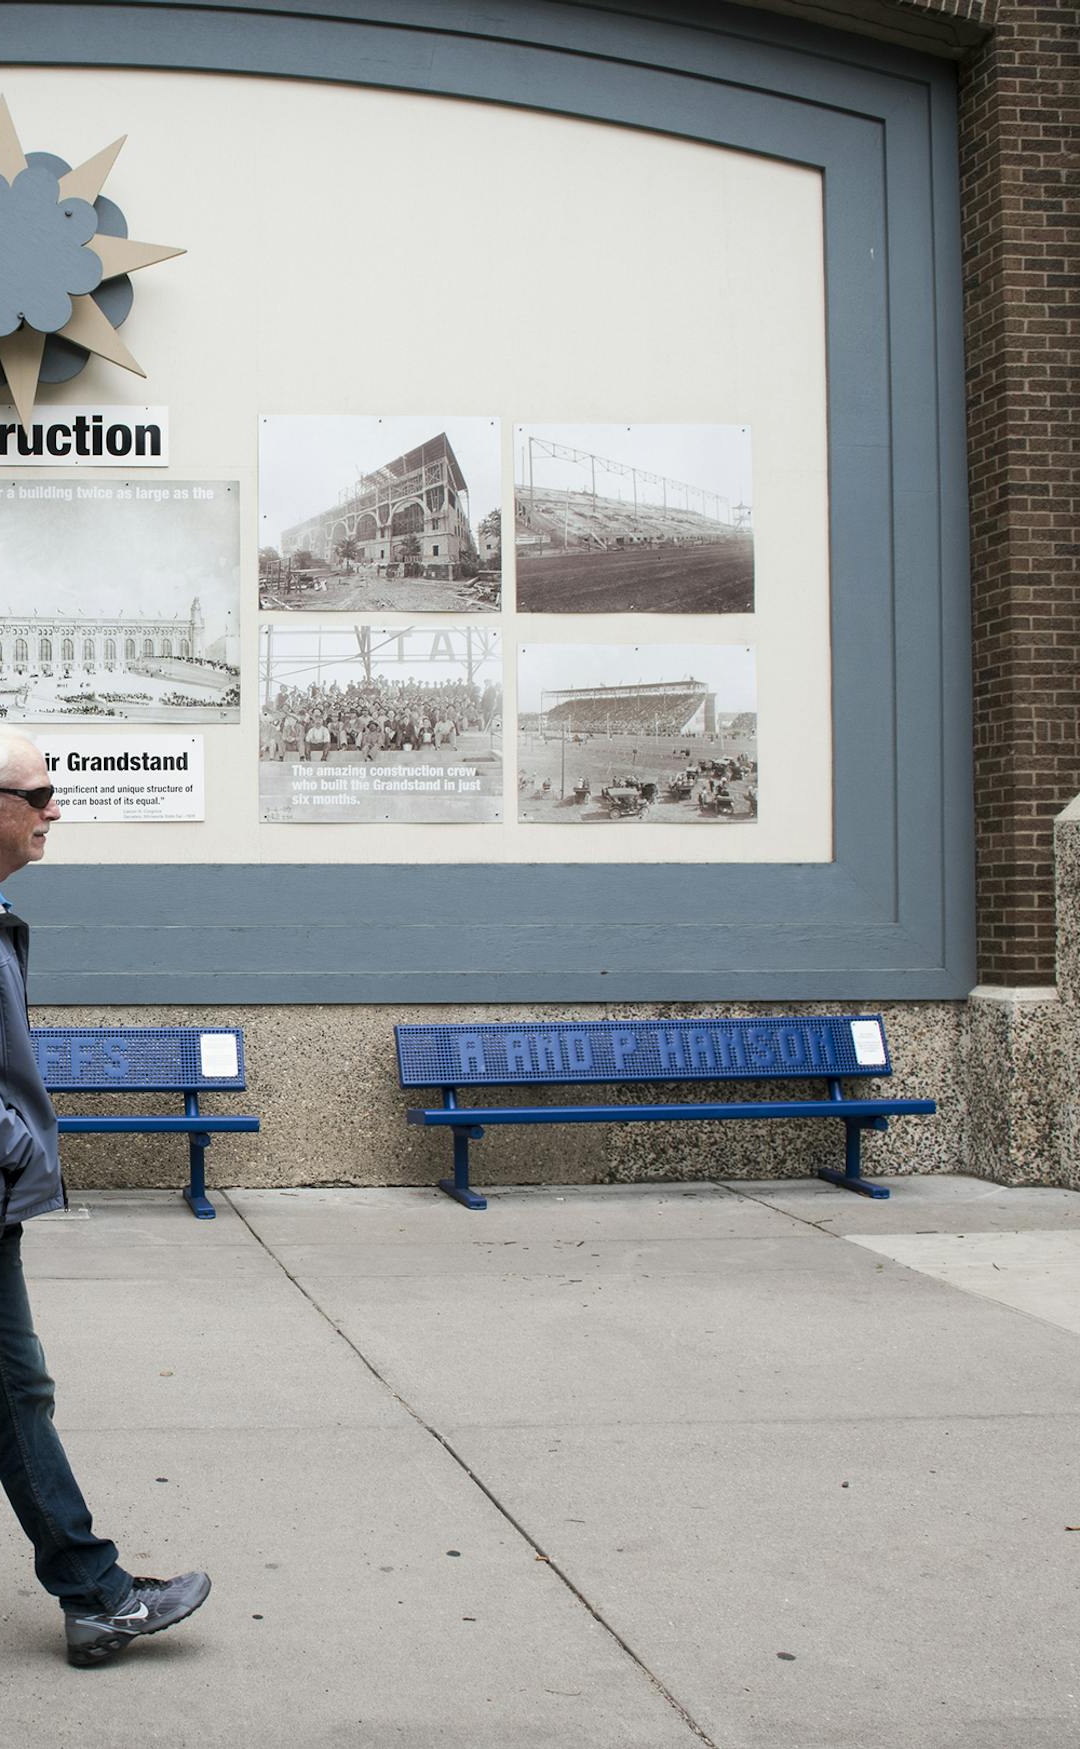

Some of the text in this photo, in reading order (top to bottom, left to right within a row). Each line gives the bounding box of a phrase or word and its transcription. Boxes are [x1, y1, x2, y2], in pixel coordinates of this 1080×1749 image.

[6, 489, 15, 499] a
[19, 486, 73, 501] building
[76, 486, 113, 499] twice
[116, 489, 133, 500] as
[135, 487, 170, 502] large
[173, 490, 189, 500] as
[192, 487, 214, 500] the
[67, 751, 189, 771] Grandstand
[291, 764, 477, 779] The amazing construction crew
[55, 785, 99, 795] agnificent
[100, 785, 116, 794] and
[117, 785, 145, 795] unique
[146, 784, 182, 794] structure
[184, 784, 194, 793] of
[291, 778, 481, 793] who built the Grandstand in just
[89, 797, 113, 806] boast
[113, 796, 122, 806] of
[123, 796, 134, 806] its
[291, 793, 361, 805] six months.
[459, 1033, 486, 1073] A
[505, 1032, 594, 1072] AND
[612, 1031, 638, 1070] P
[657, 1026, 837, 1068] HANSON
